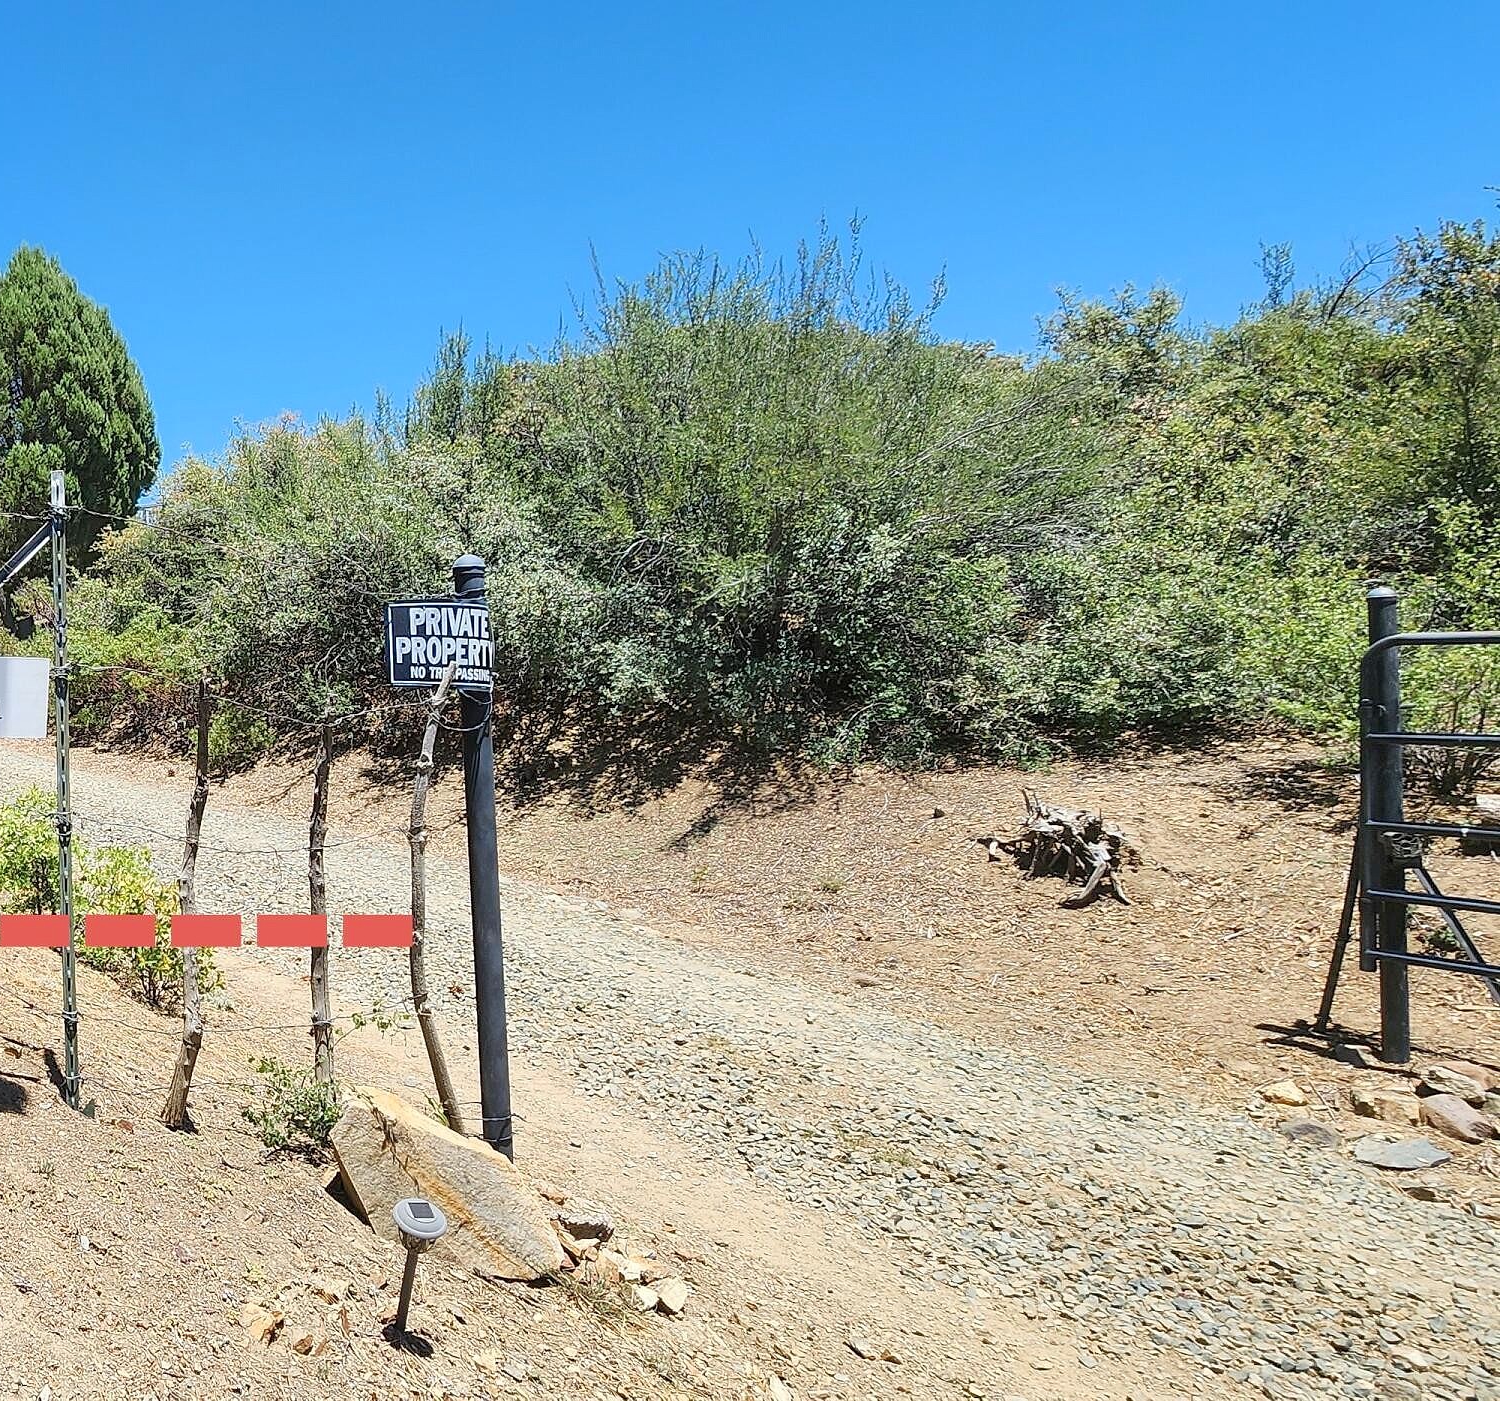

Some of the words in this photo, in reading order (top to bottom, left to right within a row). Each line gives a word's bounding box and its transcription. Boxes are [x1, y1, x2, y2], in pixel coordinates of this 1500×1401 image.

[409, 607, 490, 639] PRIVATE
[410, 665, 426, 679] NO
[429, 666, 490, 682] TREPASSING
